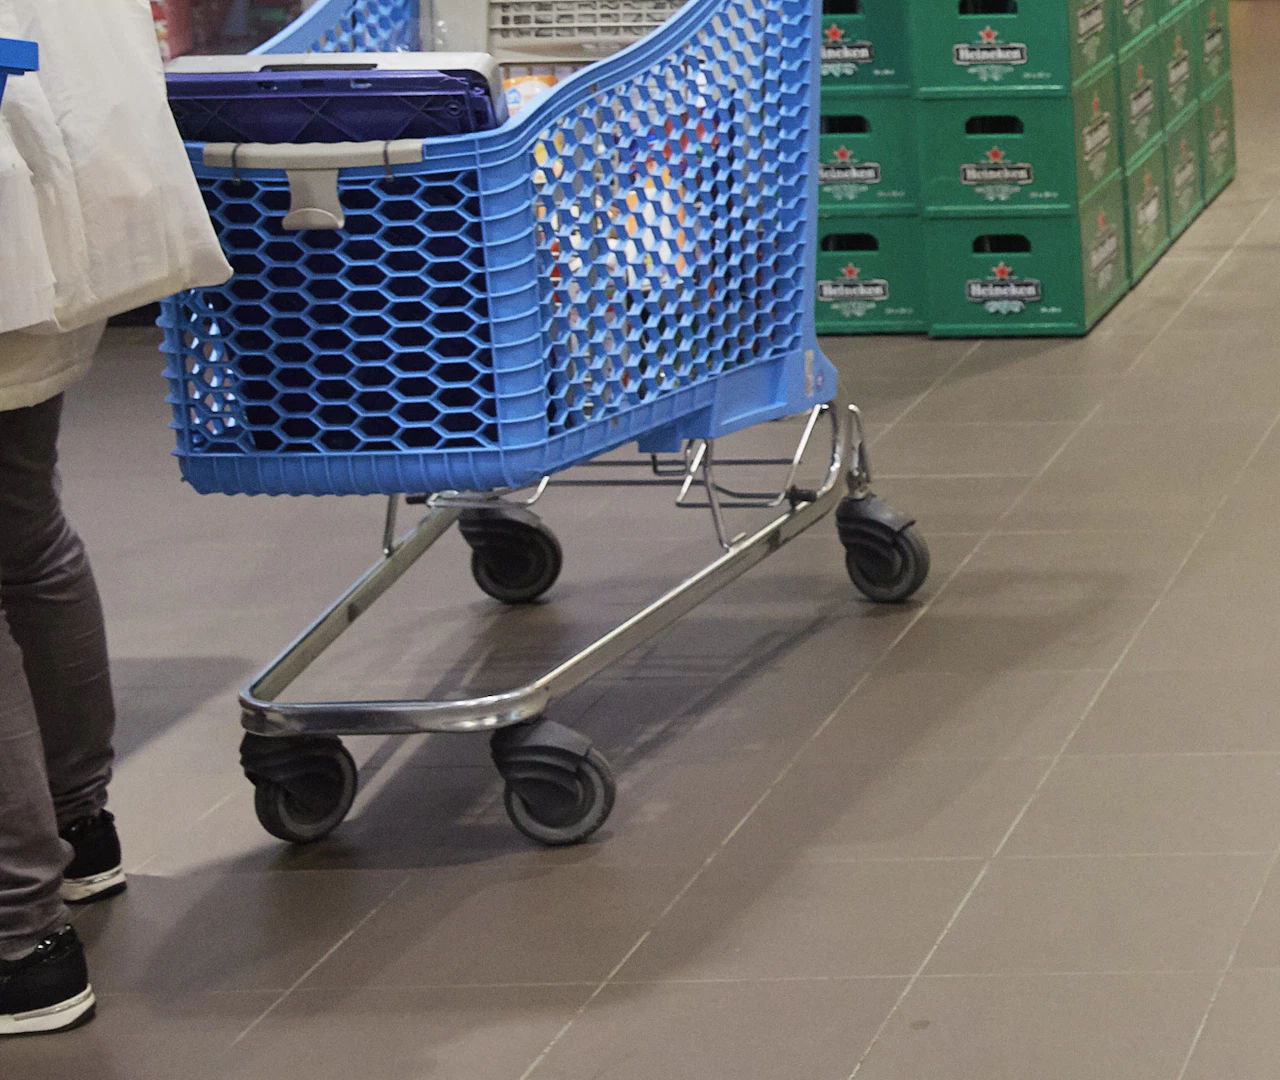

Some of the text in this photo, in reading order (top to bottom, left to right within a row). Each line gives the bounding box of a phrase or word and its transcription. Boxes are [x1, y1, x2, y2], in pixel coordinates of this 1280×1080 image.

[821, 44, 870, 59] ineken
[960, 46, 1024, 60] Heineken
[819, 167, 876, 180] eineken
[965, 166, 1029, 180] Heineken
[970, 283, 1036, 298] Heineken
